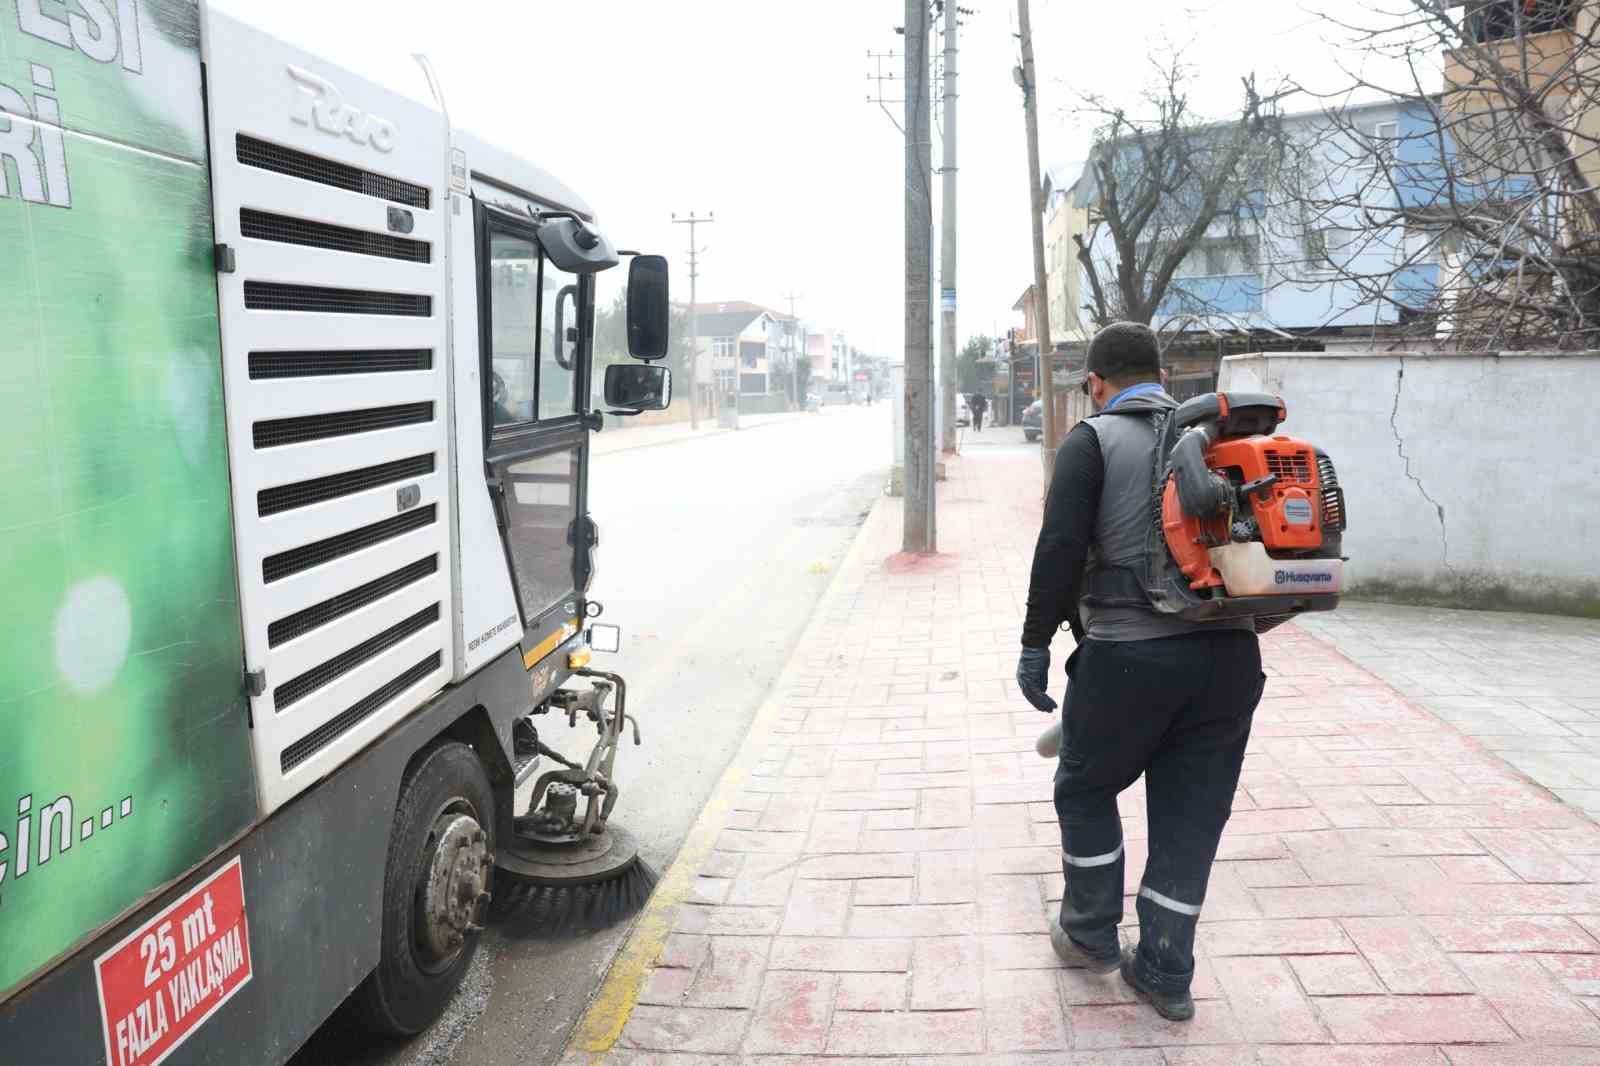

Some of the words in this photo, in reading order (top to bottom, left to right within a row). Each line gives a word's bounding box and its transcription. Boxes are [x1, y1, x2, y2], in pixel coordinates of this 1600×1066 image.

[0, 793, 133, 904] in...
[116, 990, 169, 1066] FAZLA
[168, 924, 244, 1023] YAKLAŞMA
[140, 920, 177, 988] 25
[182, 892, 216, 954] mt
